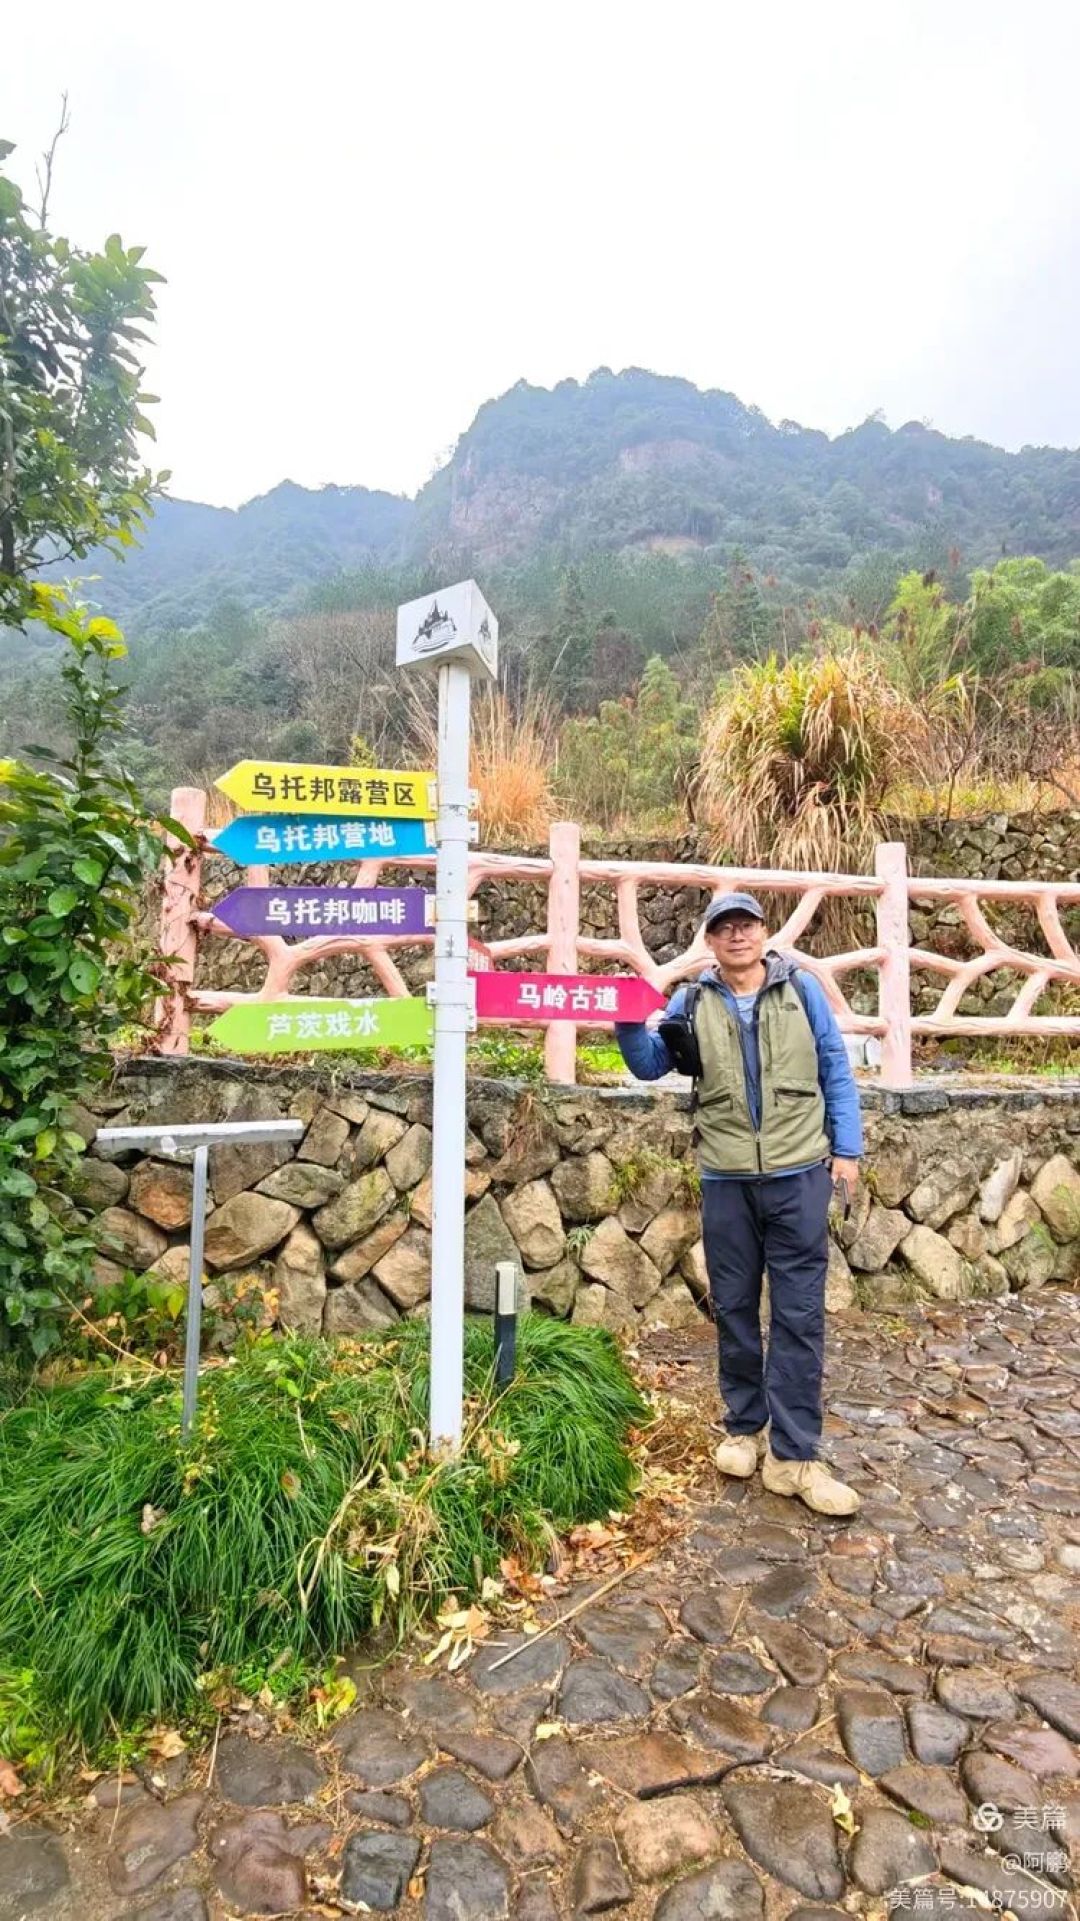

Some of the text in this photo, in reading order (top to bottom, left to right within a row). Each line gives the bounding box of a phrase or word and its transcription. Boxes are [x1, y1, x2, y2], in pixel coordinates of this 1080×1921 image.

[251, 772, 417, 806] 乌托邦露营区
[255, 822, 396, 853] 乌托邦营地
[265, 898, 407, 926] 乌托邦咖啡
[518, 983, 620, 1013] 马岭古道
[266, 1012, 380, 1041] 芦茨戏水
